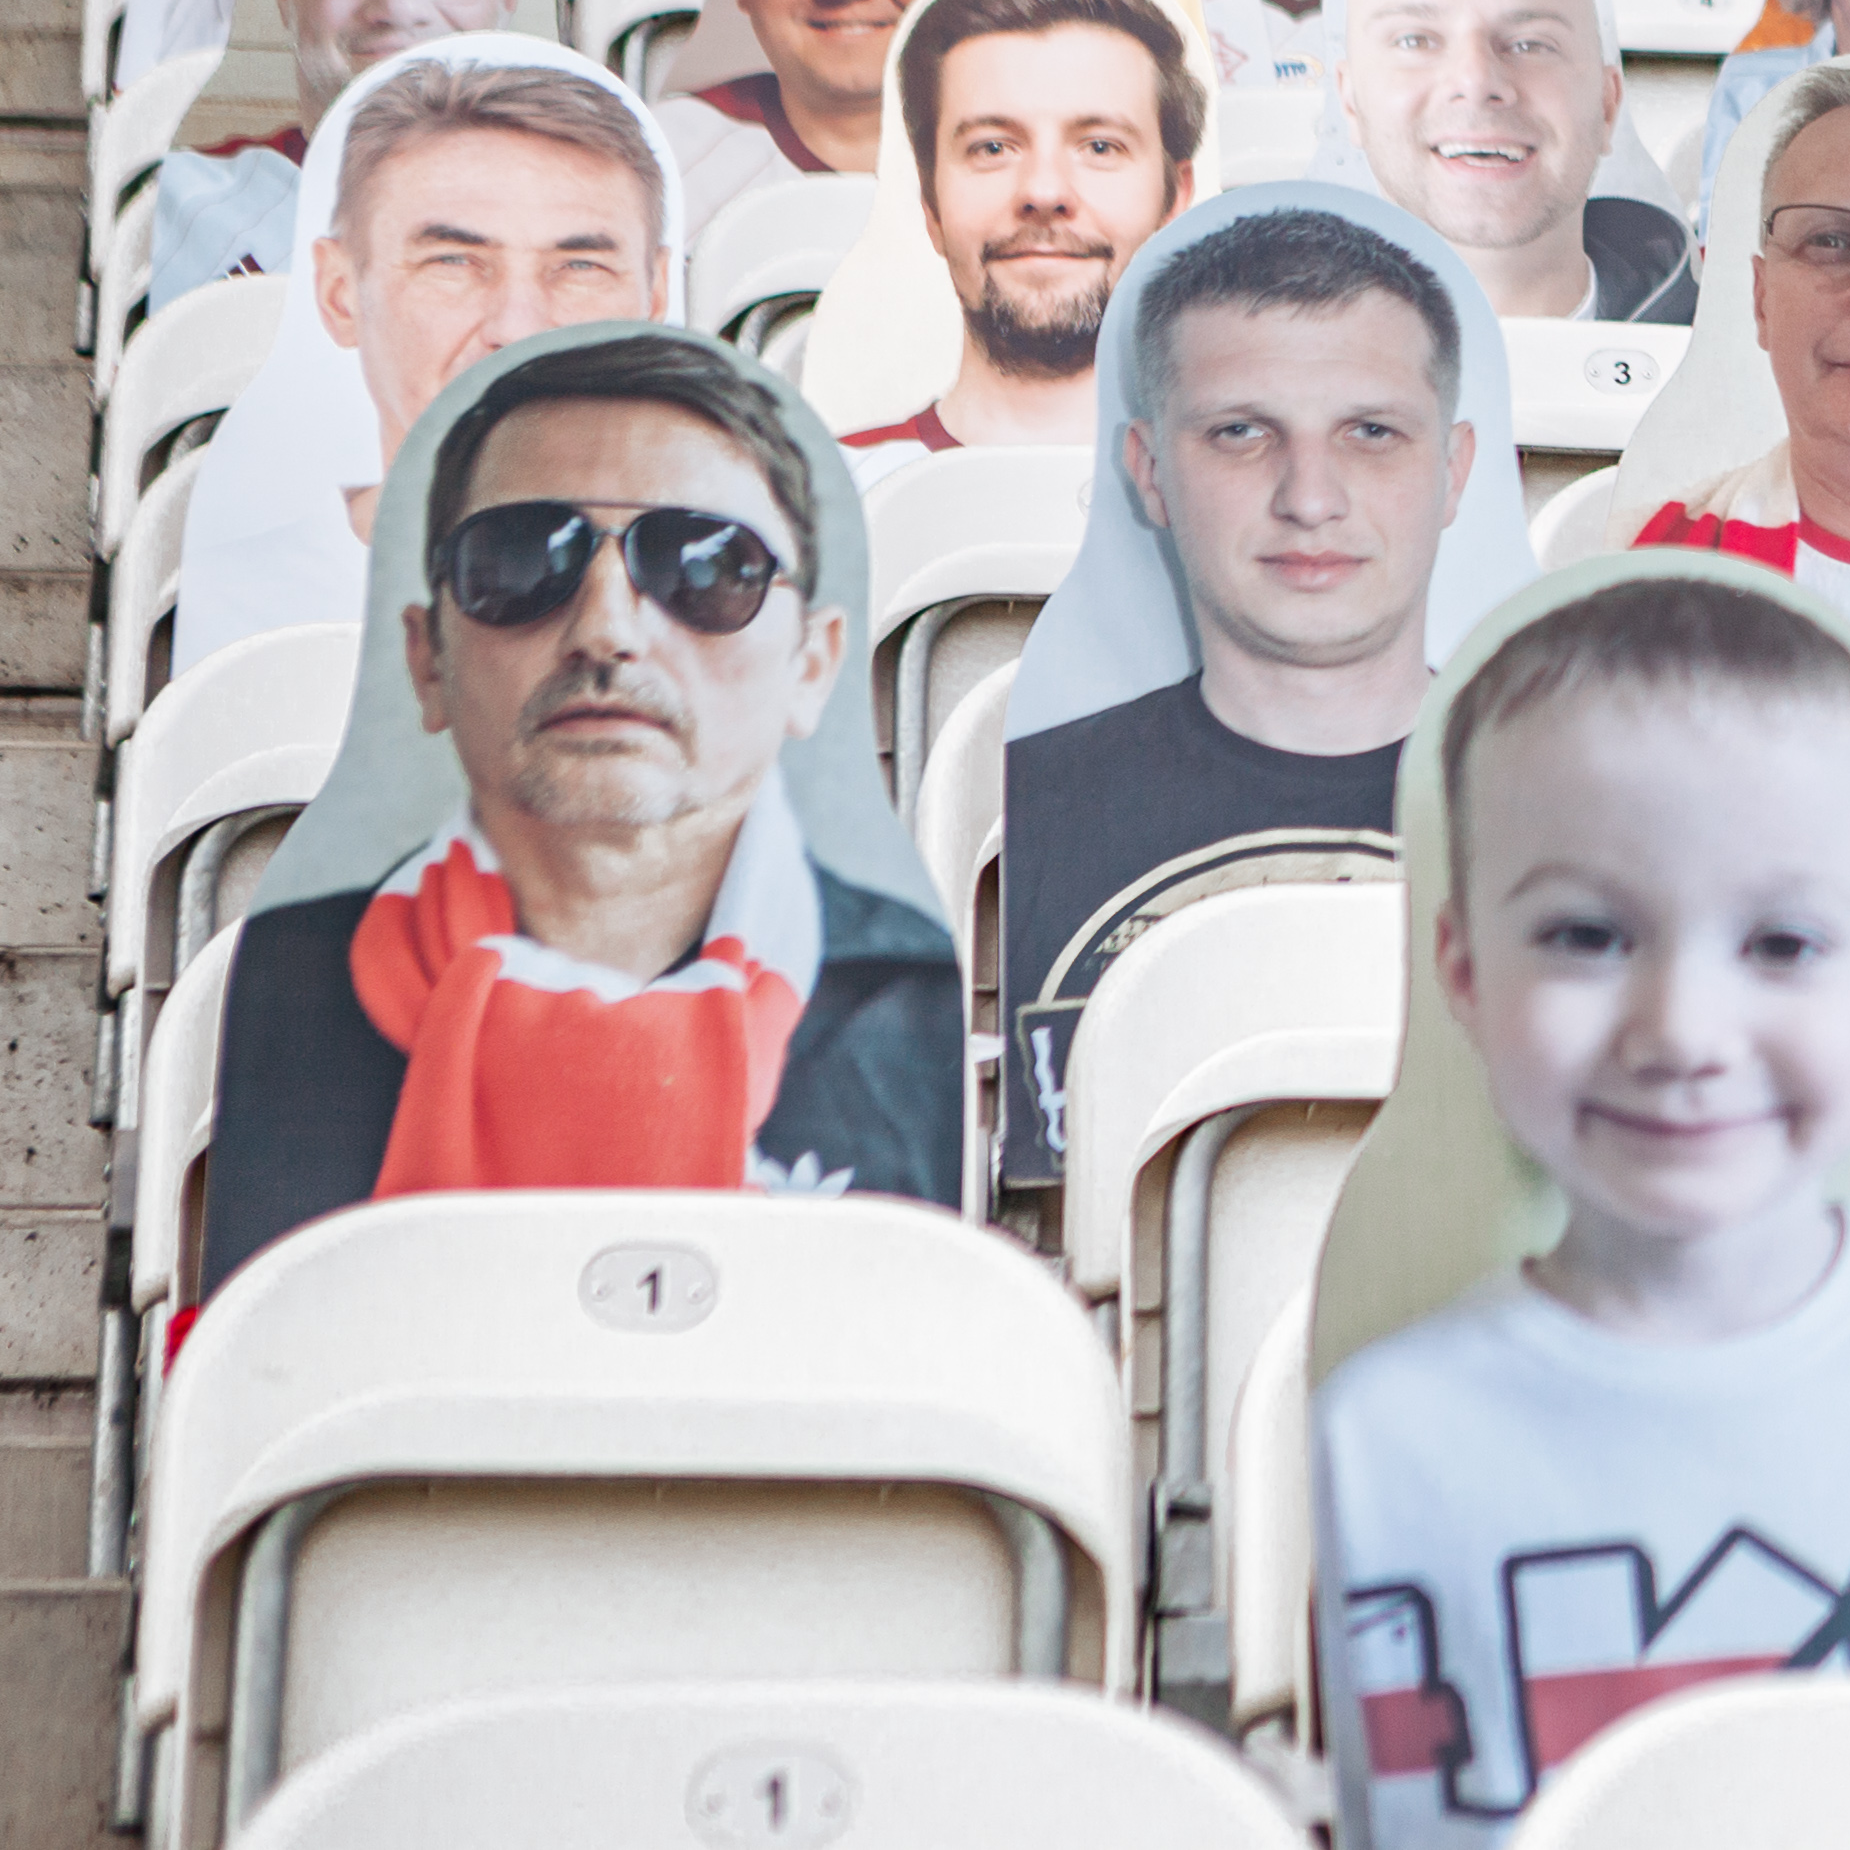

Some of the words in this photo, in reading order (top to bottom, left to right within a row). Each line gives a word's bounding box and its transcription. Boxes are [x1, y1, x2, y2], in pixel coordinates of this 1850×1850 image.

[1614, 361, 1632, 386] 3
[636, 1267, 663, 1314] 1
[765, 1774, 786, 1824] 1
